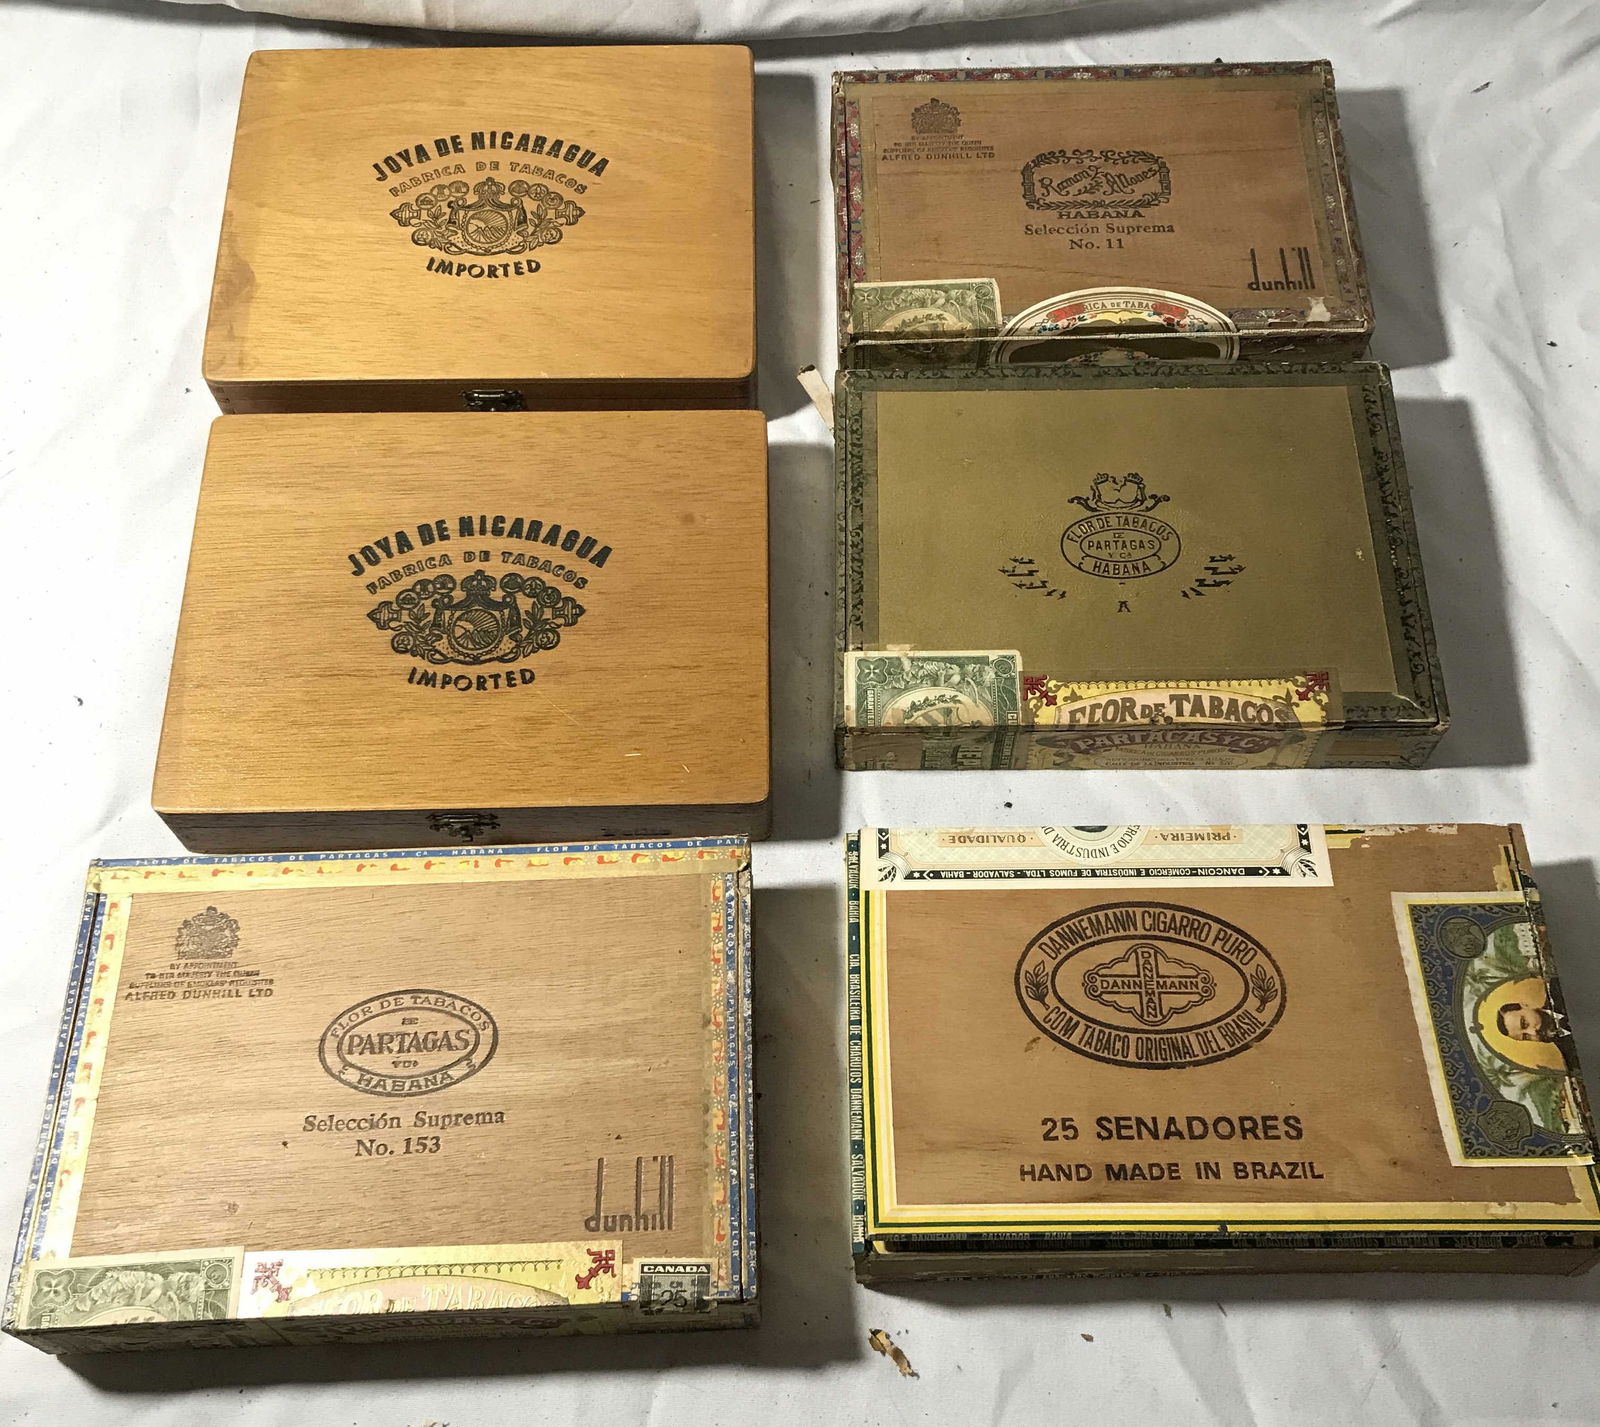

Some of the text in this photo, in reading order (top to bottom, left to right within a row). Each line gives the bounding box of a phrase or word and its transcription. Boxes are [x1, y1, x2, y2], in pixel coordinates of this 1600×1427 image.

[372, 131, 610, 182] JOYA DE NICARAGUA
[881, 153, 921, 161] ALFRED
[926, 152, 972, 160] DUNHILL
[389, 161, 589, 197] FABRICA DE TABACOS
[1057, 209, 1145, 219] HABANA
[1024, 223, 1175, 236] Selección Suprema
[1069, 238, 1125, 250] No. 11
[426, 257, 541, 278] IMPORTED
[1248, 247, 1316, 291] dunhill
[1067, 515, 1174, 543] FLOR DE TABACOS
[348, 514, 613, 577] JOYA DE NICARAGUA
[1087, 540, 1156, 551] PARTAGAS
[366, 550, 589, 595] FABRICA DE TABACOS
[1092, 560, 1150, 576] HABANA
[408, 666, 536, 691] IMPORTED
[1141, 703, 1165, 718] DE
[948, 834, 1027, 845] QUALIDADE
[1160, 831, 1231, 842] PRIMEIRA
[214, 855, 274, 863] TABACOS
[320, 851, 389, 860] PARTAGAS
[452, 848, 504, 856] HABANA
[537, 845, 569, 853] FLOR
[614, 841, 672, 850] TABACOS
[687, 839, 702, 847] DE
[1112, 844, 1120, 855] E
[941, 871, 965, 879] BAHIA
[973, 870, 1015, 879] SALVADOR
[1023, 870, 1047, 878] LTDA.
[1049, 869, 1078, 878] FUMOS
[1081, 869, 1092, 877] DE
[1140, 868, 1145, 876] E
[1039, 910, 1258, 966] DANNEMANN CIGARRO PURO
[77, 960, 95, 1027] PARTAGAS
[125, 988, 274, 1001] ALFRED DUNHILL LTD
[1101, 979, 1200, 991] DANNEMANN
[849, 973, 861, 1021] BRASILEIRA
[59, 980, 77, 1048] PARTAGAS
[330, 995, 491, 1039] FLOR DE TABACOS
[849, 1024, 861, 1036] DE
[1042, 1006, 1267, 1062] COM TABACO ORIGINAL DEL BRASIL
[346, 1029, 471, 1055] PARTAGAS
[849, 1040, 862, 1084] CHARUTOS
[357, 1071, 455, 1091] HABANA
[303, 1110, 505, 1132] Selección Suprema
[850, 1088, 864, 1140] DANNEMANN
[1041, 1115, 1303, 1141] 25 SENADORES
[355, 1136, 441, 1157] No. 153
[1020, 1161, 1324, 1182] HAND MADE IN BRAZIL
[584, 1155, 674, 1232] dunhill
[731, 1221, 740, 1257] FLOR
[643, 1265, 708, 1273] CANADA
[661, 1290, 688, 1308] 25
